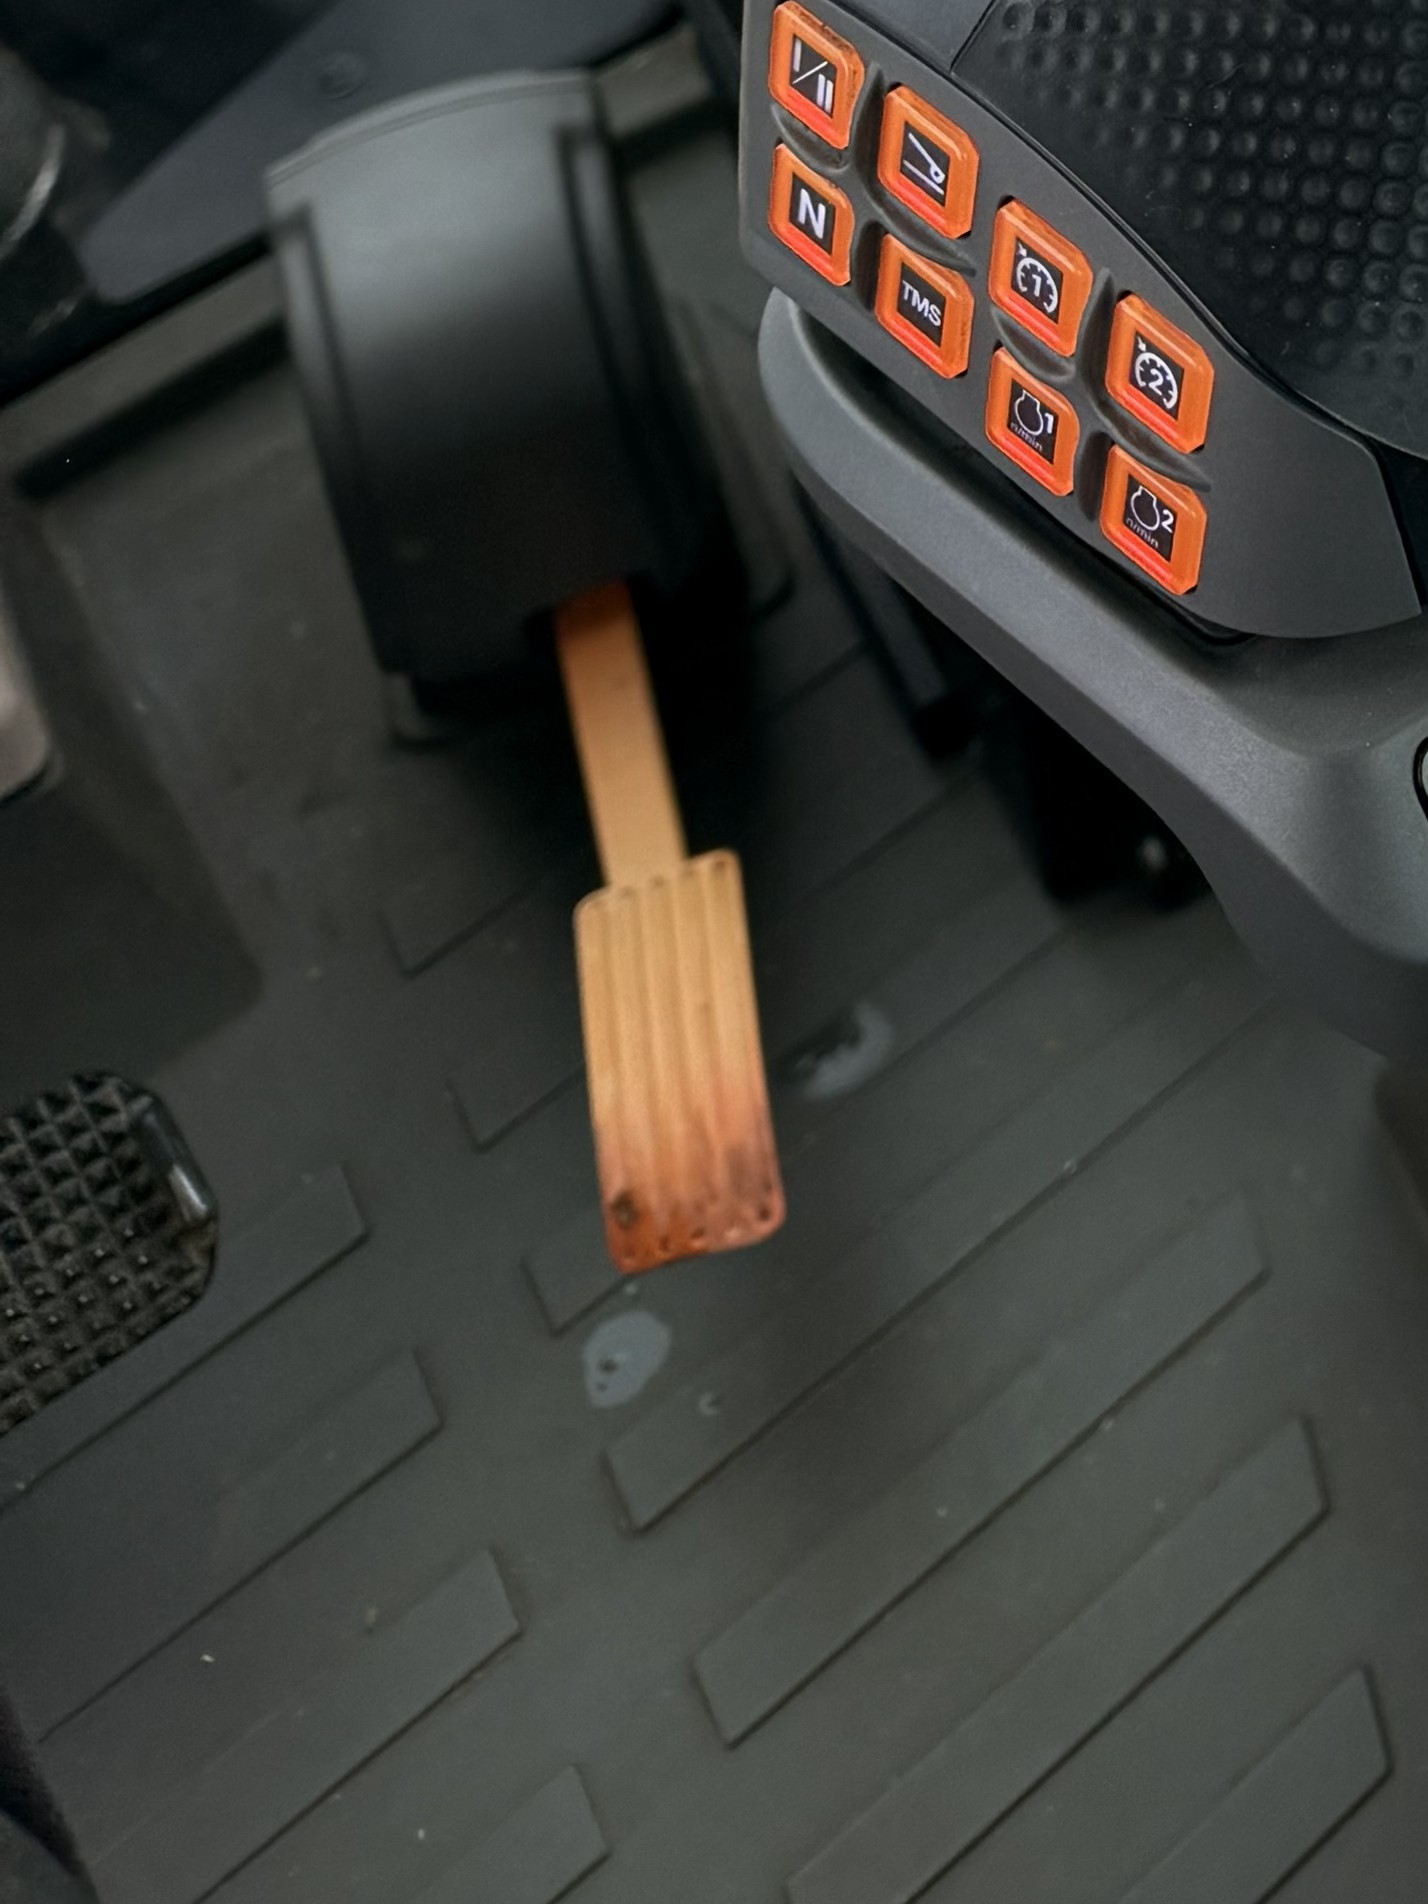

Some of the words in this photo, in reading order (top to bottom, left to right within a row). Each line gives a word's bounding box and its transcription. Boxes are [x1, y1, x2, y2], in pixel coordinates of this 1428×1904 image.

[798, 187, 826, 240] N
[901, 279, 942, 327] TMS
[1010, 421, 1044, 453] n/min
[1125, 516, 1160, 548] n/min
[1161, 509, 1174, 533] 2
